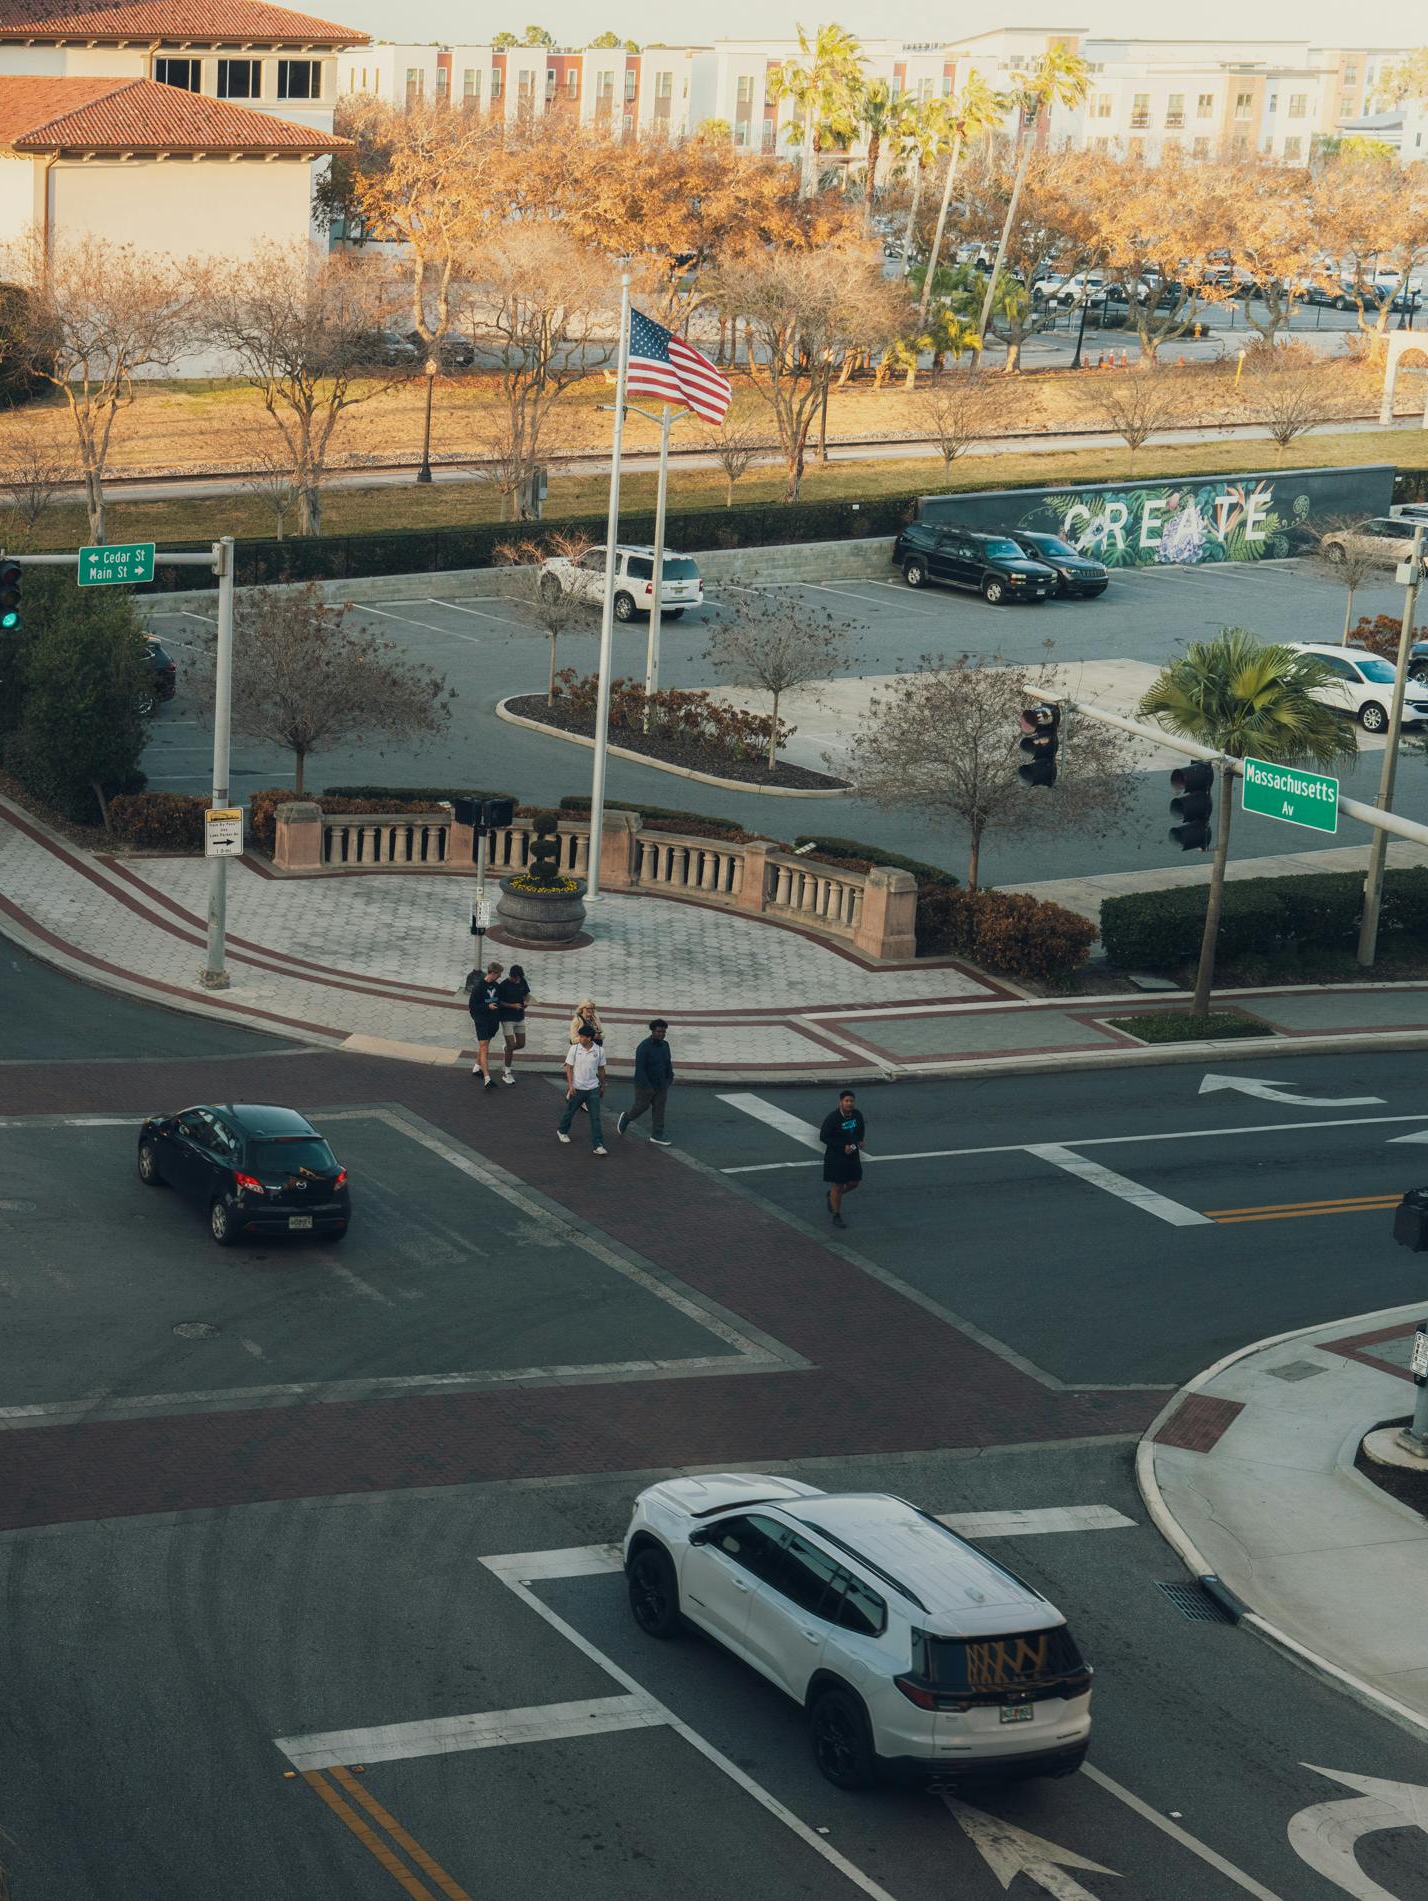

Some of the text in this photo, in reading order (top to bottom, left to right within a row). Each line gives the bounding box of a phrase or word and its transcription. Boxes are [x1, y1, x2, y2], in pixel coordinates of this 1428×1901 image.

[1063, 493, 1272, 551] CREATE
[103, 549, 145, 564] Cedar St
[89, 565, 128, 580] Main St
[1246, 763, 1335, 803] Massachusetts
[1281, 801, 1294, 817] Av
